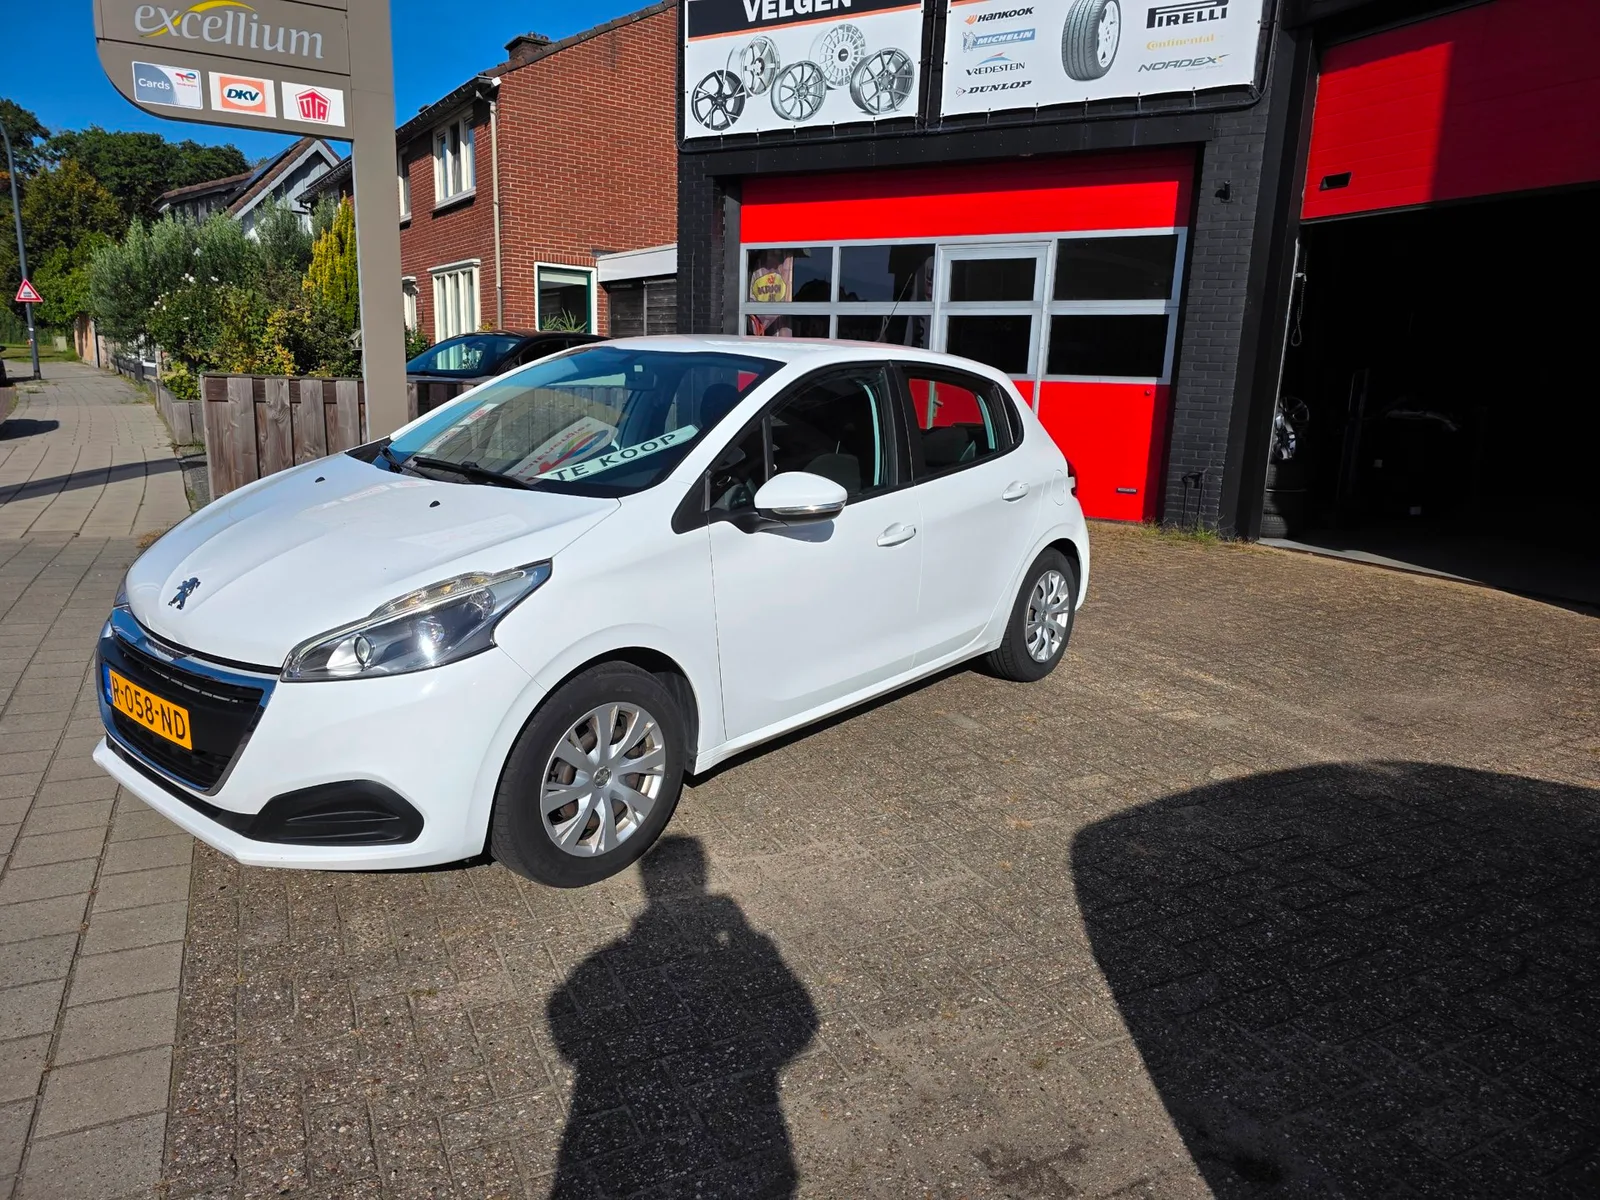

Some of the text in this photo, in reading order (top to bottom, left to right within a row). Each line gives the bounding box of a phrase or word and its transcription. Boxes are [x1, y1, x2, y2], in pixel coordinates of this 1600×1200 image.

[1146, 0, 1229, 29] PIRELLI
[134, 4, 324, 59] excellium
[977, 31, 1034, 45] MICHELIN
[966, 62, 1026, 76] VREDESTEIN
[1137, 55, 1218, 72] NORDEX
[138, 77, 171, 91] Cards
[967, 80, 1032, 94] DUNLOP
[226, 88, 260, 102] DKV
[298, 91, 328, 120] UTA
[551, 433, 676, 481] TE KOOP
[112, 675, 186, 740] R-058-ND
